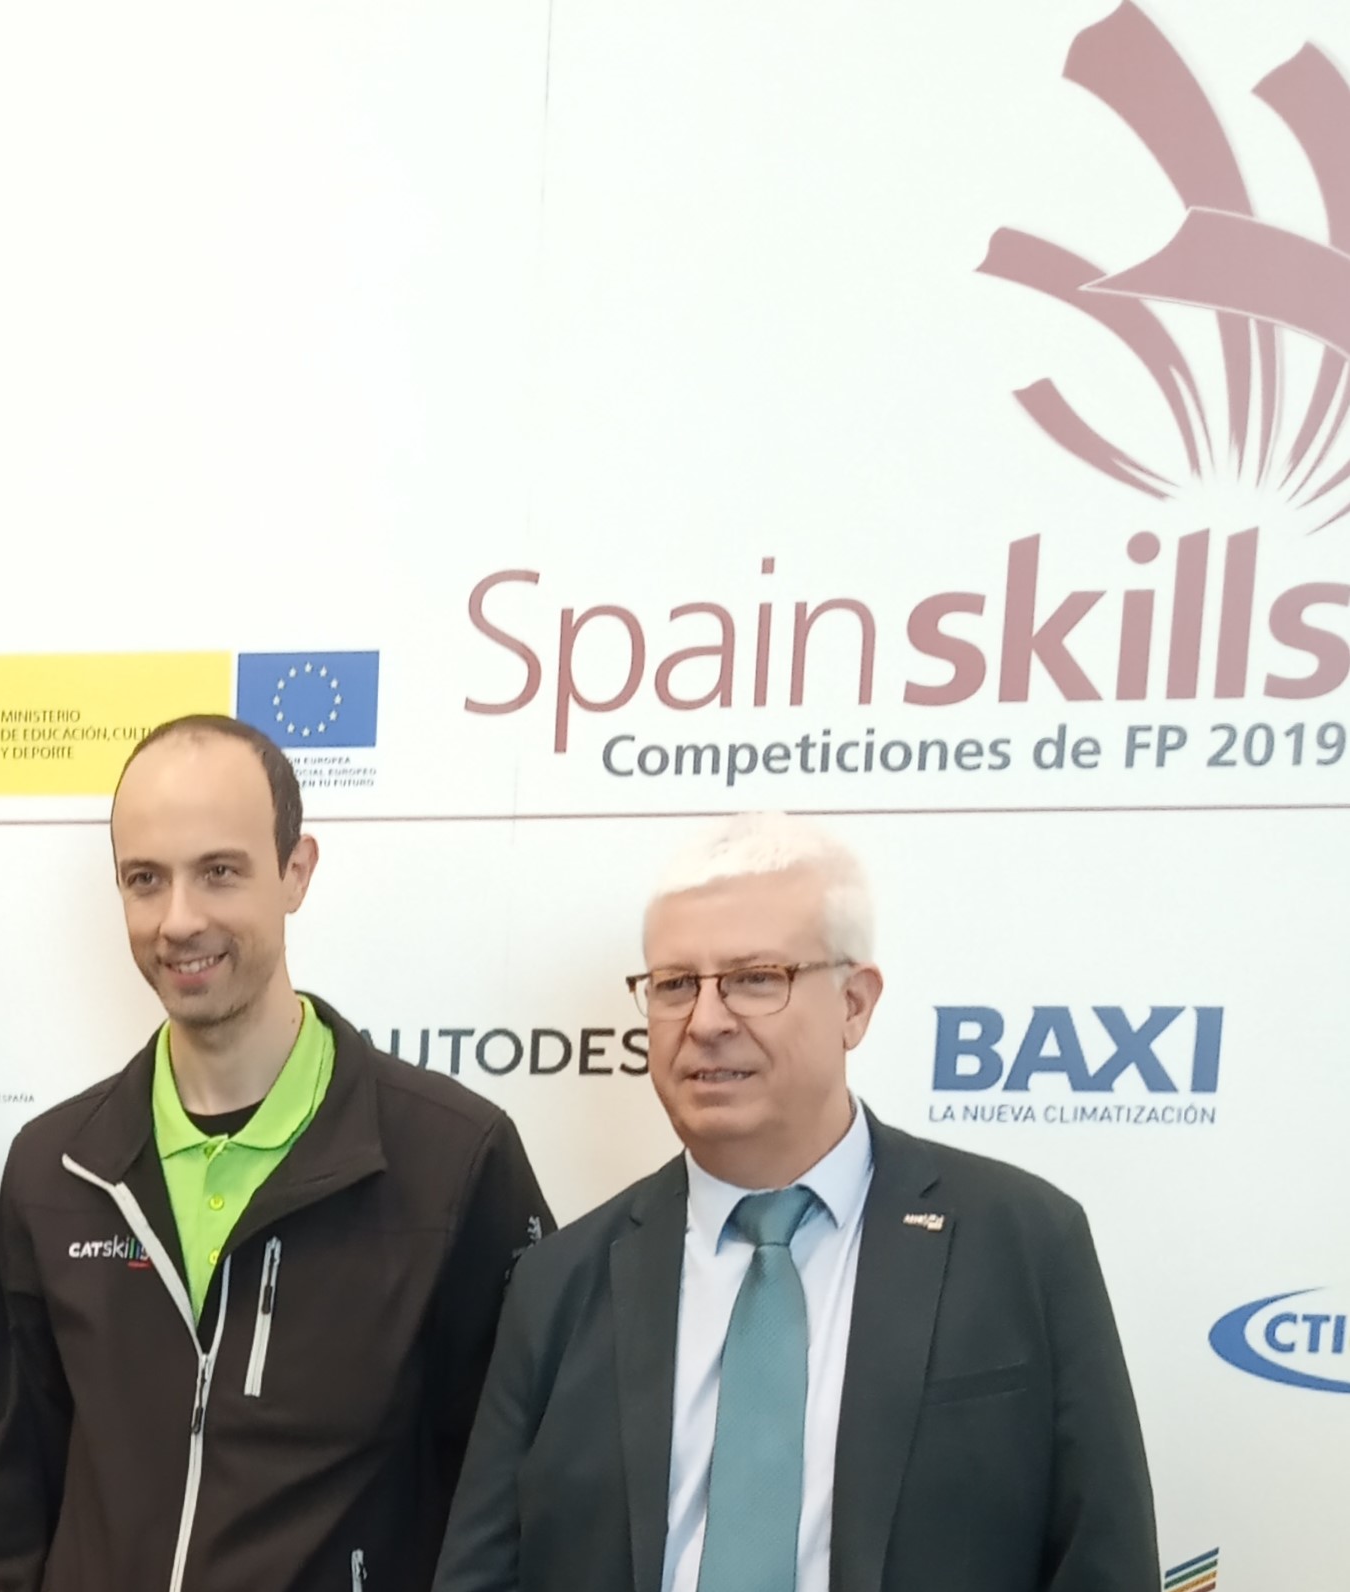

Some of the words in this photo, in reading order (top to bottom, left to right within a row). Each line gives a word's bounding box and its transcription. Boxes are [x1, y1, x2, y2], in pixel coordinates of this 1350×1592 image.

[0, 709, 81, 724] MINISTERIO
[0, 728, 19, 742] DE
[113, 727, 152, 742] CULT
[0, 746, 9, 760] Y
[12, 746, 74, 760] DEPORTE
[602, 728, 1013, 786] Competiciones
[1032, 725, 1103, 771] de
[1124, 725, 1188, 770] FP
[1207, 721, 1347, 769] 2019
[932, 1005, 1224, 1094] BAXI
[928, 1104, 956, 1123] LA
[961, 1104, 1037, 1124] NUEVA
[1043, 1102, 1217, 1125] CLIMATIZACIÓN
